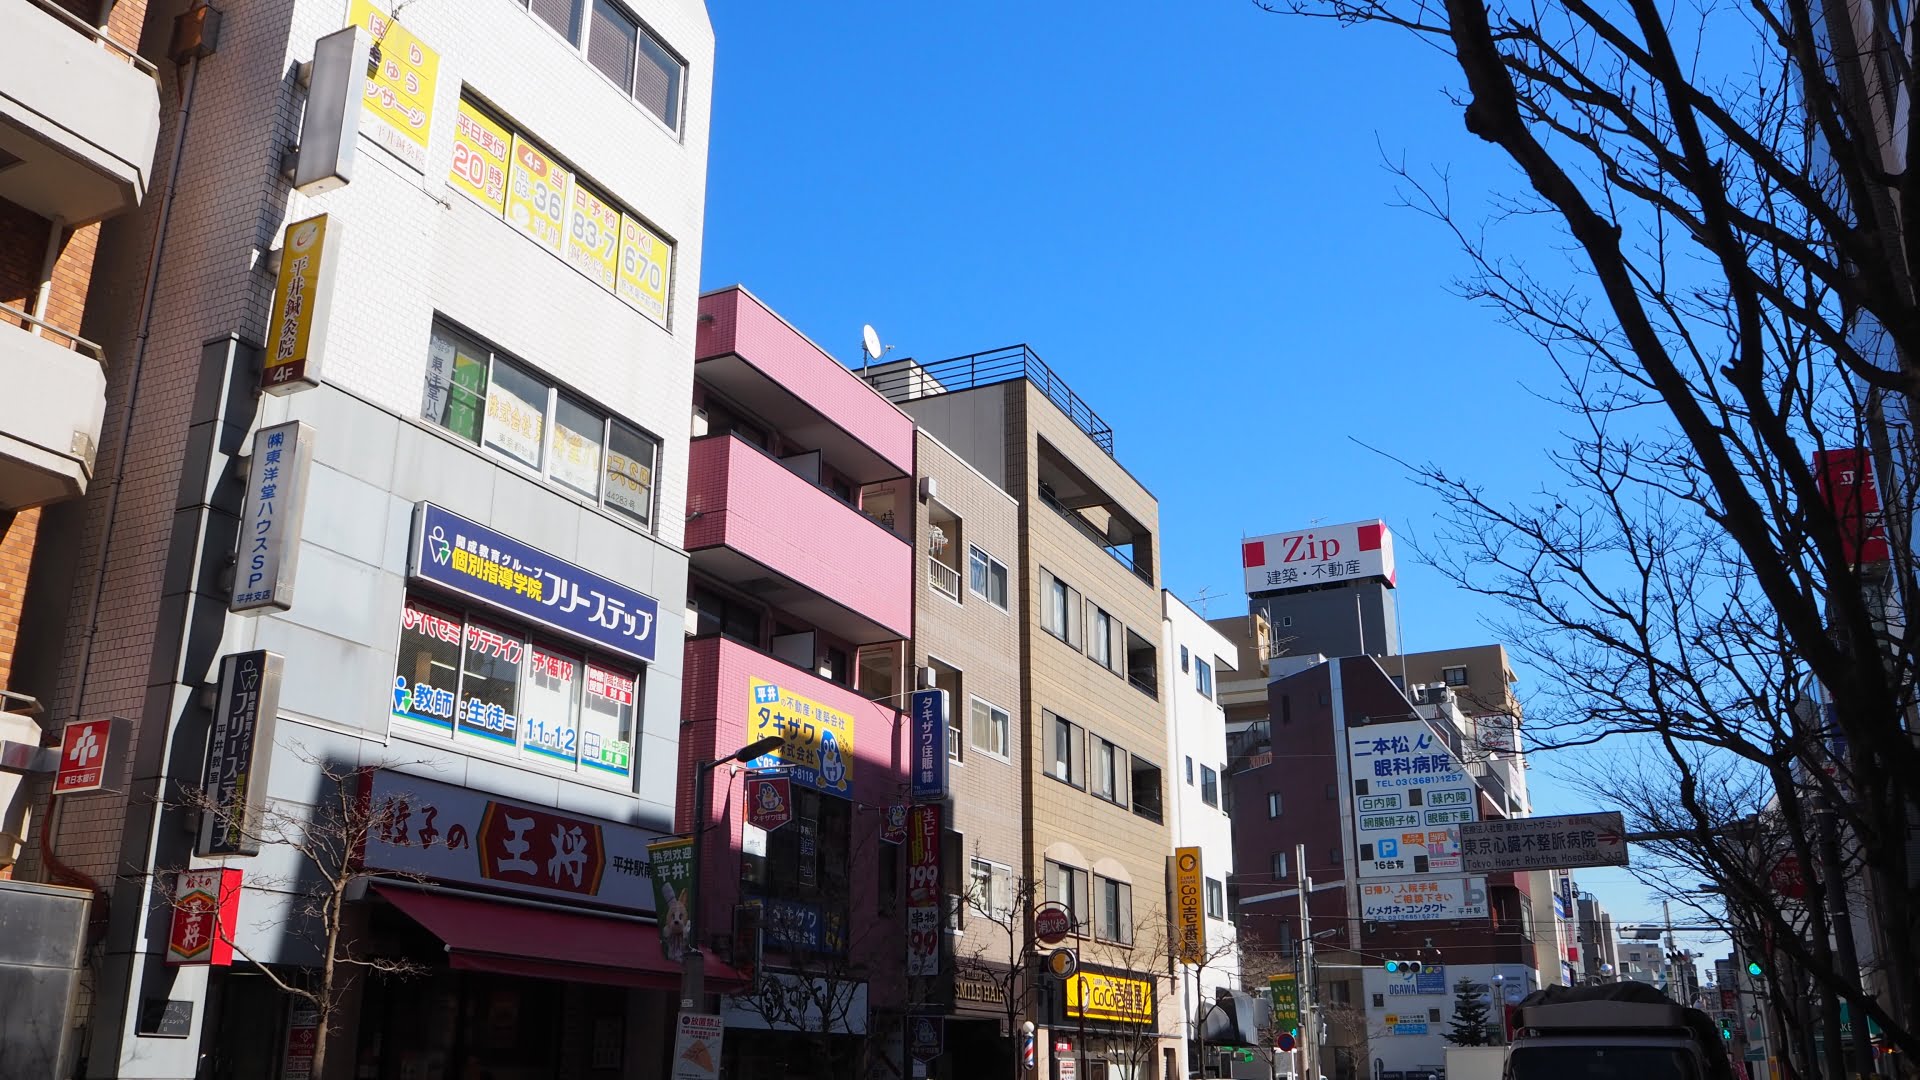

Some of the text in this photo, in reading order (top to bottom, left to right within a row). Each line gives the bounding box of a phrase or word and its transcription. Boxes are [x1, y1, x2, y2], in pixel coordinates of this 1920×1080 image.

[365, 79, 427, 129] ッサージ
[456, 111, 506, 161] 平日受付
[521, 149, 544, 173] 4F
[551, 168, 652, 255] 当 日予約 OK!
[533, 181, 561, 222] 36
[623, 245, 661, 291] 670
[276, 255, 310, 361] 平井鍼灸院
[273, 365, 293, 382] 4F
[454, 533, 544, 579] 開成教育グループ
[1283, 533, 1340, 562] Zip
[451, 547, 543, 602] 個別指導学院
[1267, 559, 1361, 586] 建築・不動産
[236, 588, 272, 604] 平井支店
[542, 571, 653, 642] フリーステップ
[468, 625, 524, 665] サテライン
[532, 651, 574, 683] 予備校
[414, 683, 454, 718] 教師
[757, 685, 777, 703] 平井
[757, 706, 816, 746] タキザワ
[209, 723, 227, 785] 平井教室
[1354, 735, 1410, 758] 二本松
[1374, 754, 1451, 777] 眼科病院
[62, 772, 97, 786] 東日本銀行
[1376, 773, 1464, 788] TEL 03(3681)1257
[1362, 791, 1468, 810] 白内障 緑内障
[1363, 814, 1417, 829] 網膜硝子体
[1462, 823, 1504, 835] 医療法人社団
[1506, 820, 1564, 833] 東京ハートサミット
[922, 808, 936, 865] 生ビール
[1464, 830, 1598, 856] 東京心臓不整脈病院
[496, 812, 589, 889] 王将
[652, 846, 692, 864] 热烈欢迎
[1467, 859, 1492, 869] Tokyo
[1496, 856, 1522, 868] Heart
[1525, 853, 1558, 865] Rhythm
[1561, 851, 1600, 863] Hospital
[657, 862, 690, 882] 平井!
[909, 865, 938, 889] 199
[1374, 860, 1405, 870] 16台有
[1376, 904, 1447, 915] メガネ・コンタクト
[183, 899, 202, 949] 王将
[955, 982, 981, 1000] SMILE
[1389, 983, 1418, 995] OGAWA
